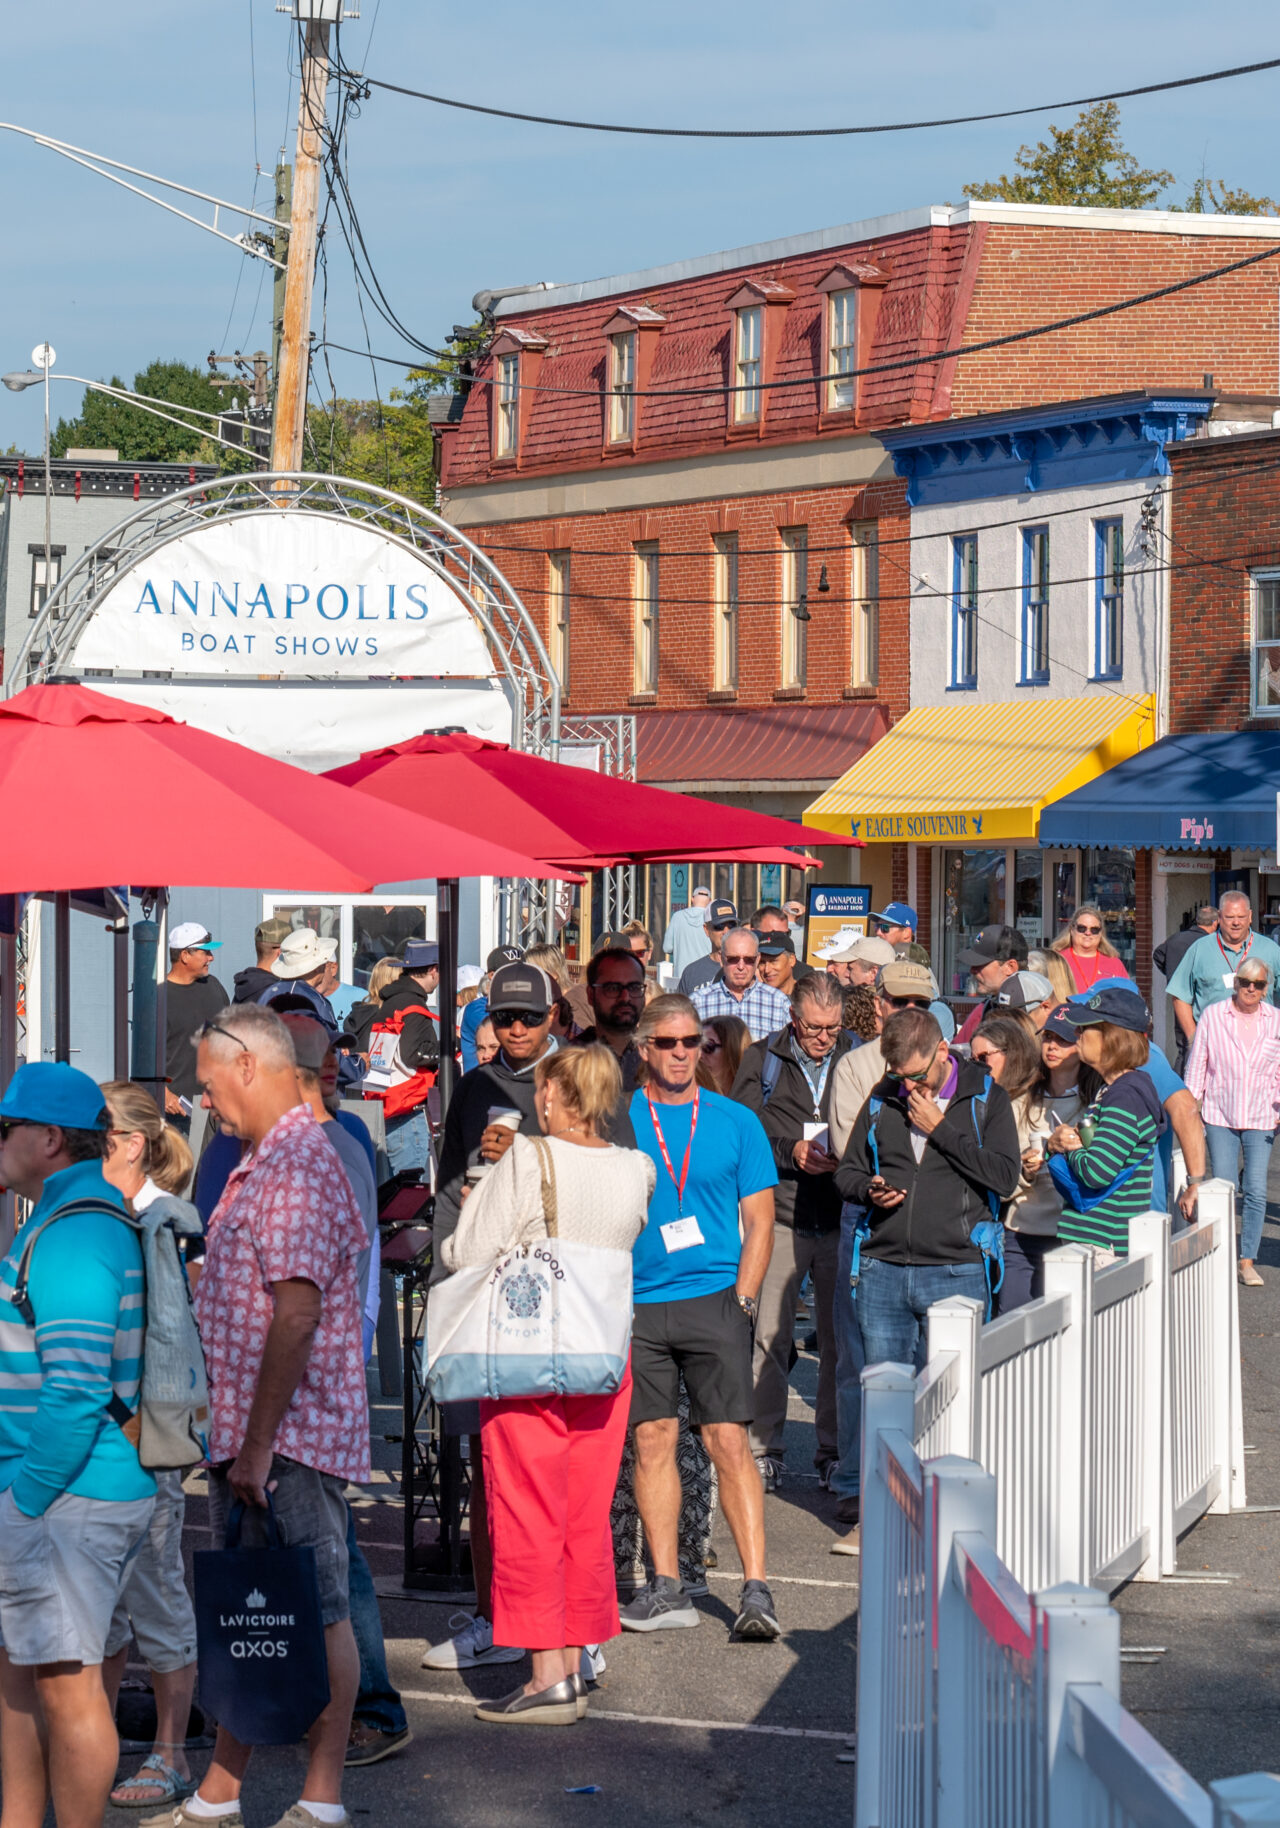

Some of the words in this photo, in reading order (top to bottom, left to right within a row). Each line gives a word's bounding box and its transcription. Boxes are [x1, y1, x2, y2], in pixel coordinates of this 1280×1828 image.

[133, 578, 429, 621] ANNAPOLIS
[181, 632, 256, 654] BOAT
[275, 635, 379, 656] SHOWS
[866, 817, 904, 838] EAGLE
[907, 815, 967, 837] SOUVENIR
[1180, 817, 1214, 845] Pip's
[829, 896, 863, 905] ANNAPOLIS
[230, 1641, 288, 1658] axos
